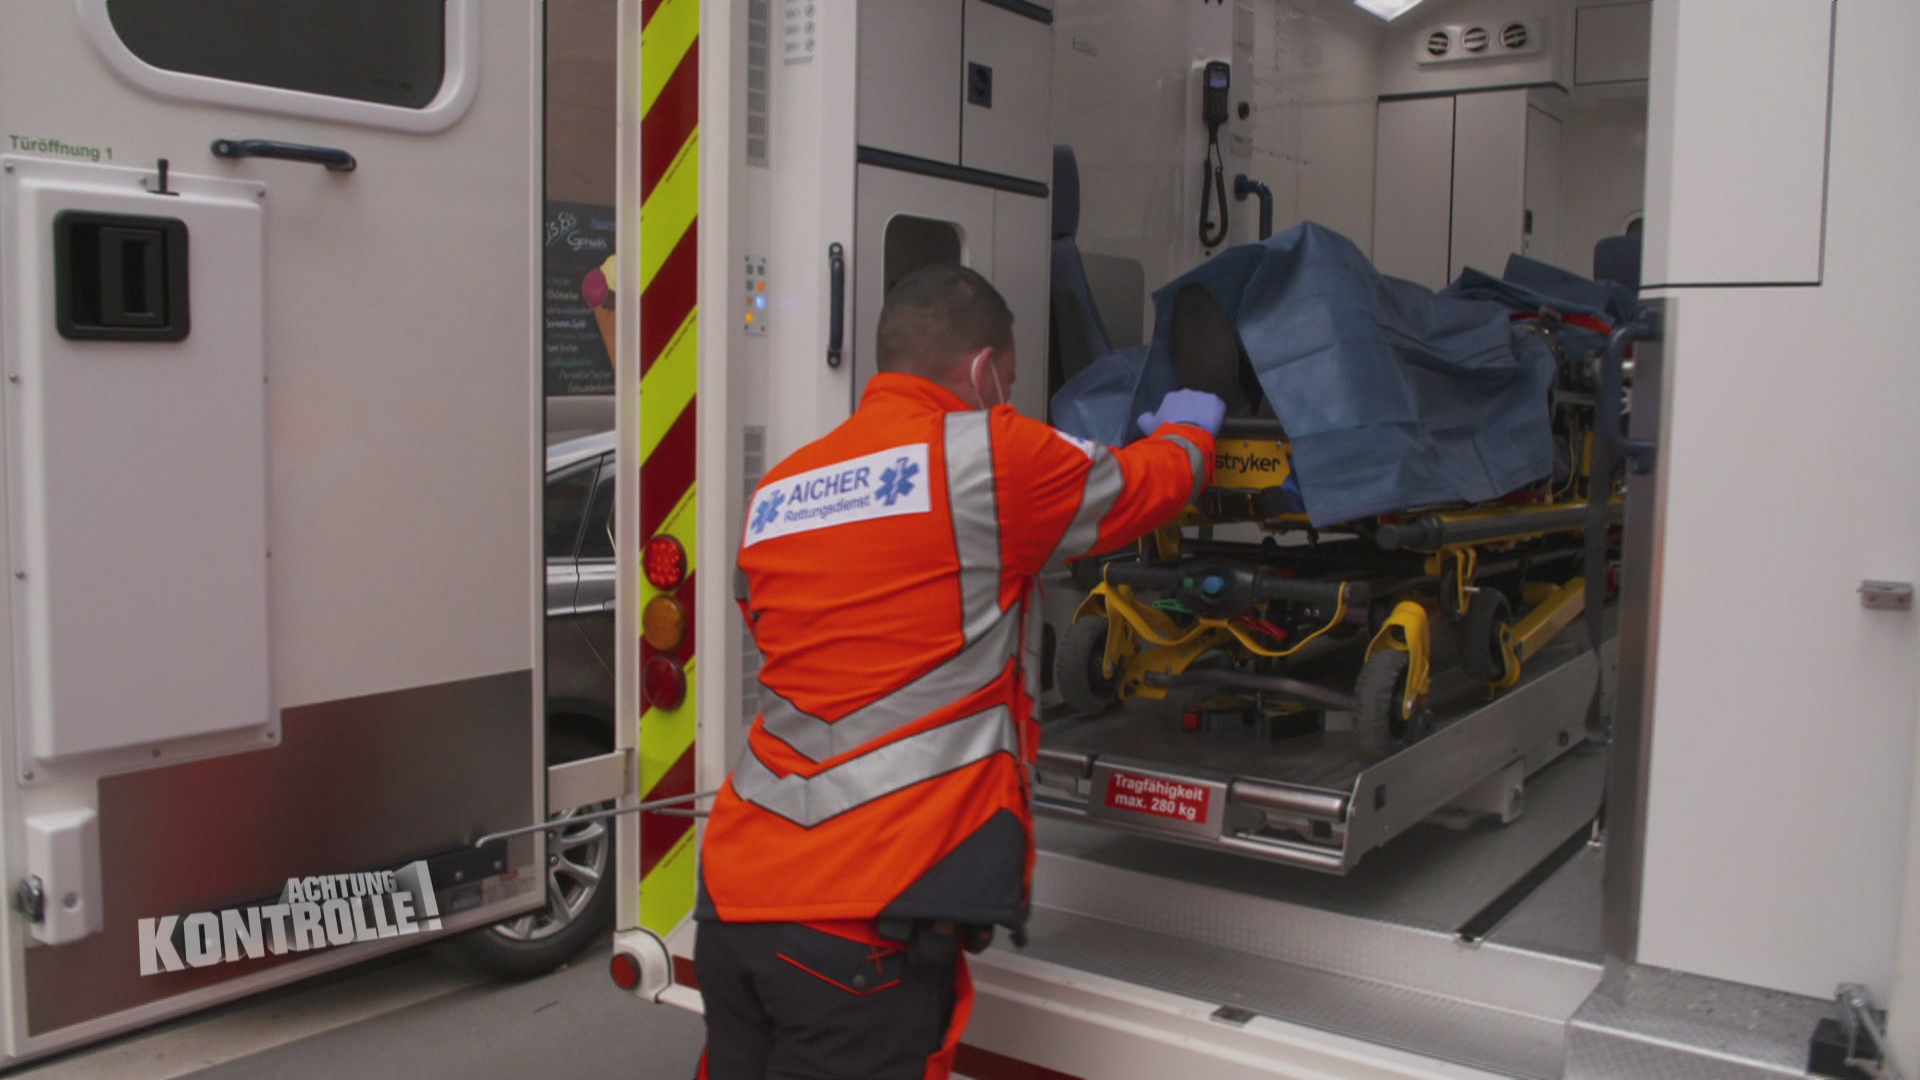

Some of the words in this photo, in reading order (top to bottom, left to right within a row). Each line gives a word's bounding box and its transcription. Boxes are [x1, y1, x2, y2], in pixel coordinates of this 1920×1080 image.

[9, 134, 100, 162] Türöffnung
[106, 146, 112, 160] 1
[1215, 452, 1280, 473] stryker
[787, 466, 870, 506] AICHER
[784, 495, 870, 522] Rettungsdienst
[1114, 773, 1203, 801] Tragfähigkeit
[1115, 794, 1147, 809] max.
[1151, 797, 1176, 814] 280
[1178, 802, 1197, 820] kg
